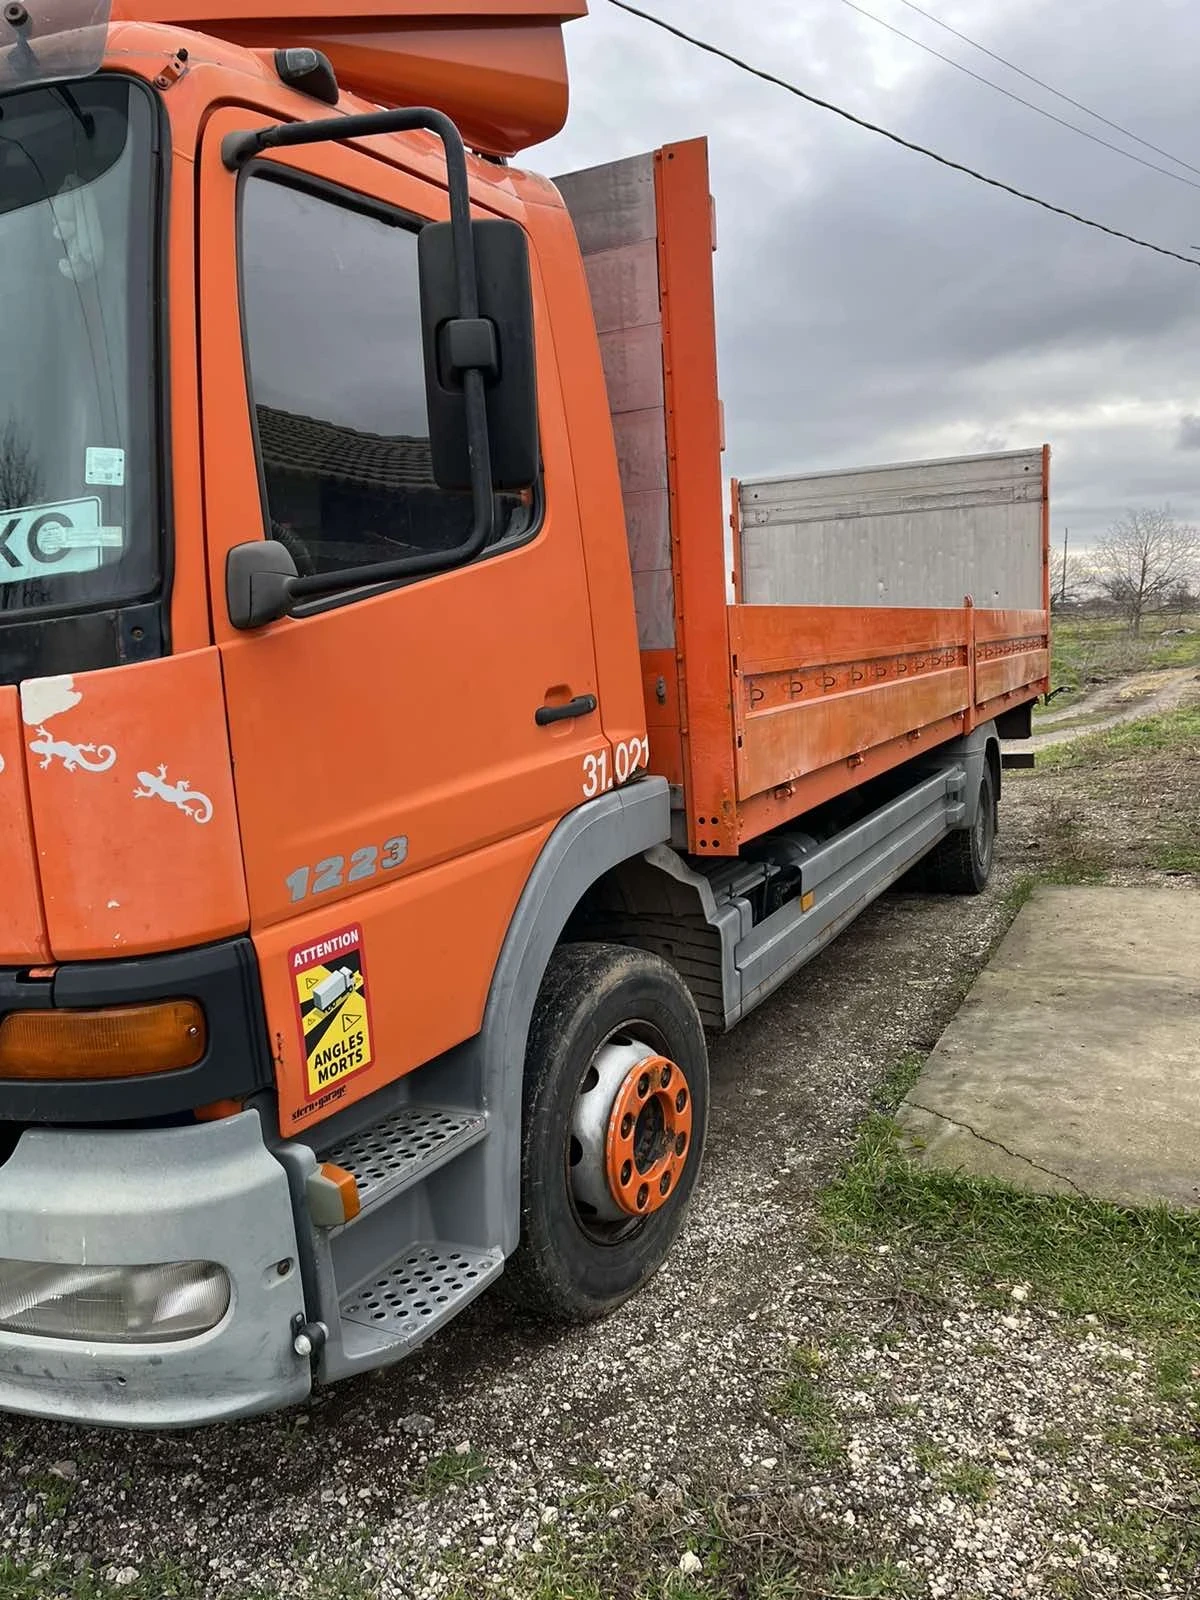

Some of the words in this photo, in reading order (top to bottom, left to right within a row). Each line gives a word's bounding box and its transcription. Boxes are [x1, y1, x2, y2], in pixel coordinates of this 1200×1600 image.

[286, 836, 409, 903] 1223
[294, 929, 359, 968] ATTENTION
[314, 1031, 364, 1070] ANGLES
[317, 1048, 363, 1085] MORTS
